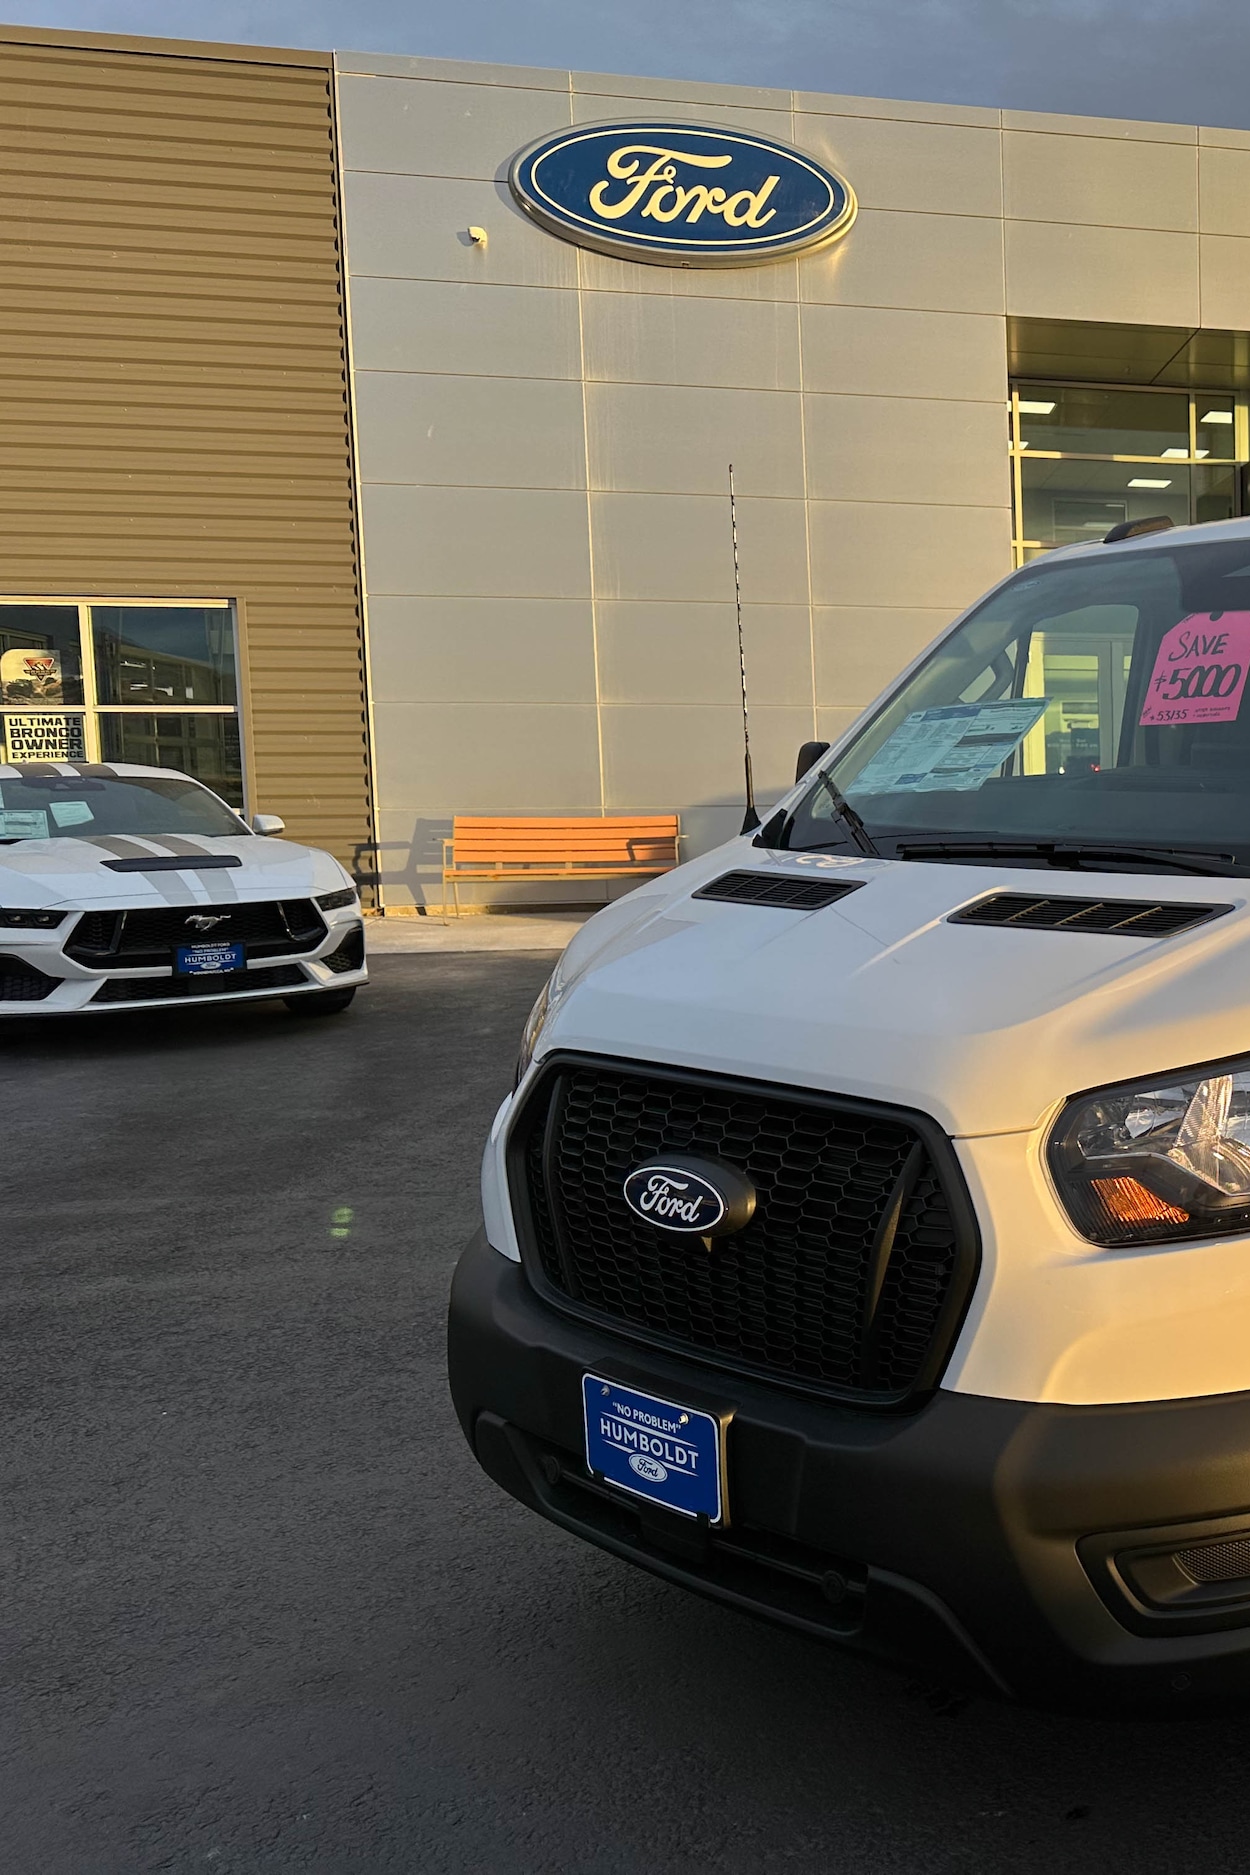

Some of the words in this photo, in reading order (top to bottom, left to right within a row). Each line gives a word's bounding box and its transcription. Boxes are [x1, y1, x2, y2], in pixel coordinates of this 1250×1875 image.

[589, 145, 781, 229] Ford
[1168, 631, 1230, 662] SAVE
[1155, 664, 1242, 700] $5000
[9, 717, 81, 727] ULTIMATE
[10, 727, 82, 738] BRONCO
[11, 739, 83, 750] OWNER
[12, 751, 84, 759] EXPERIENCE
[184, 953, 237, 964] HUMBOLDT
[640, 1174, 704, 1222] Ford
[612, 1401, 632, 1417] "NO
[632, 1408, 681, 1434] PROBLEM"
[600, 1417, 699, 1469] HUMBOLDT
[637, 1458, 659, 1478] Ford
